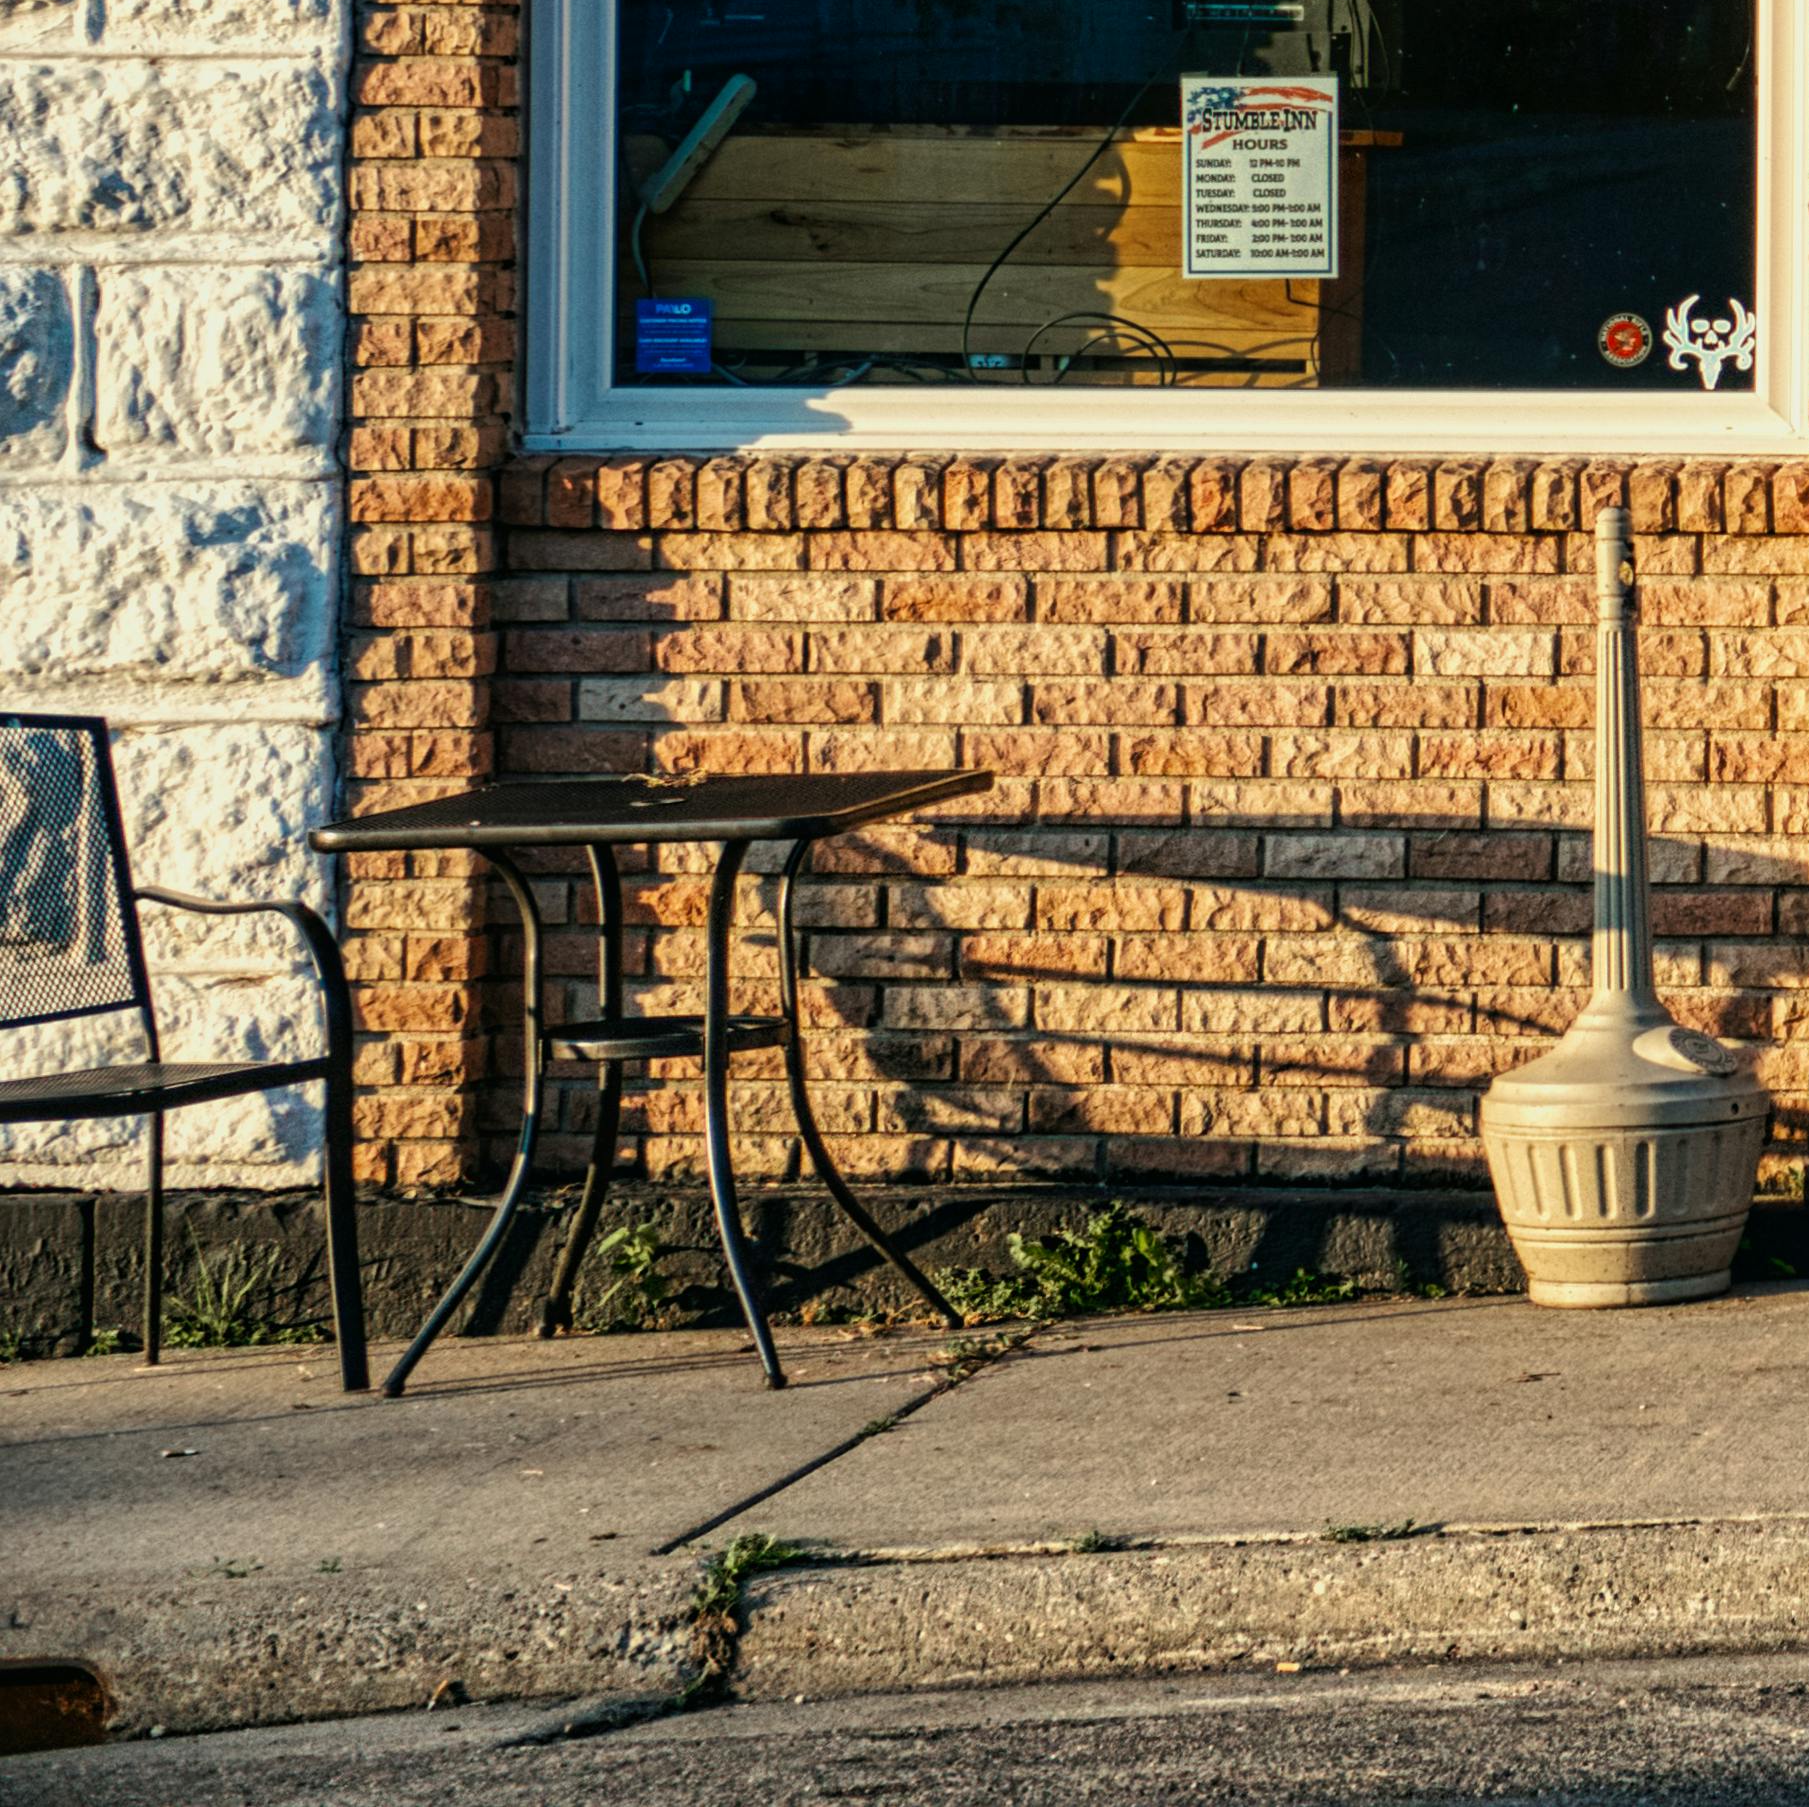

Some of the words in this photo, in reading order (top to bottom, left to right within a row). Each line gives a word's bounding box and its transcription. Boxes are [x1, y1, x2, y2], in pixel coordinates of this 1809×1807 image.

[1202, 108, 1280, 131] STUMBLE
[1283, 108, 1317, 131] INN
[1232, 139, 1288, 150] HOURS
[1196, 159, 1231, 168] SUNDAY:
[1287, 159, 1300, 168] PM
[1196, 174, 1236, 183] MONDAY:
[1252, 174, 1285, 183] CLOSED
[1196, 189, 1235, 198] TUESDAY:
[1253, 189, 1286, 198] CLOSED
[1196, 204, 1250, 213] WEDNESDAY:
[1307, 204, 1321, 213] AM
[1196, 219, 1242, 228] THURSDAY:
[1251, 219, 1270, 228] 4:00
[1309, 219, 1323, 228] AM
[1196, 234, 1228, 242] FRIDAY:
[1309, 234, 1323, 242] AM
[1196, 249, 1241, 258] SATURDAY:
[1311, 249, 1325, 258] AM
